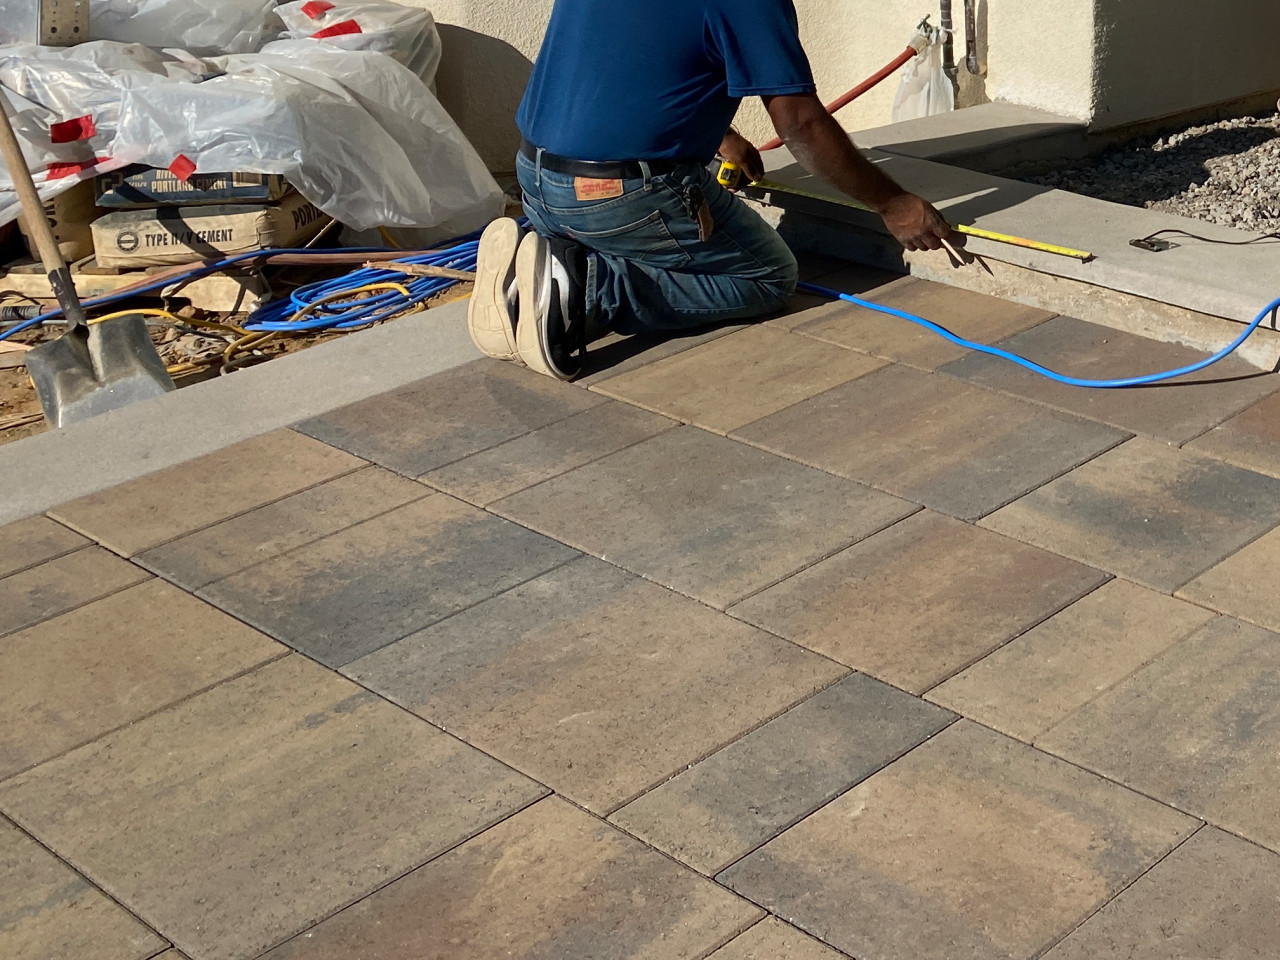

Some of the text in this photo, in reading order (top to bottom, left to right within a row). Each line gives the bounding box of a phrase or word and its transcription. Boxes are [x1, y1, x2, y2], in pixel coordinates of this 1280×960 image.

[151, 177, 227, 193] PORTLAND CEMENT
[145, 233, 168, 247] TYPE
[196, 229, 233, 244] CEMENT
